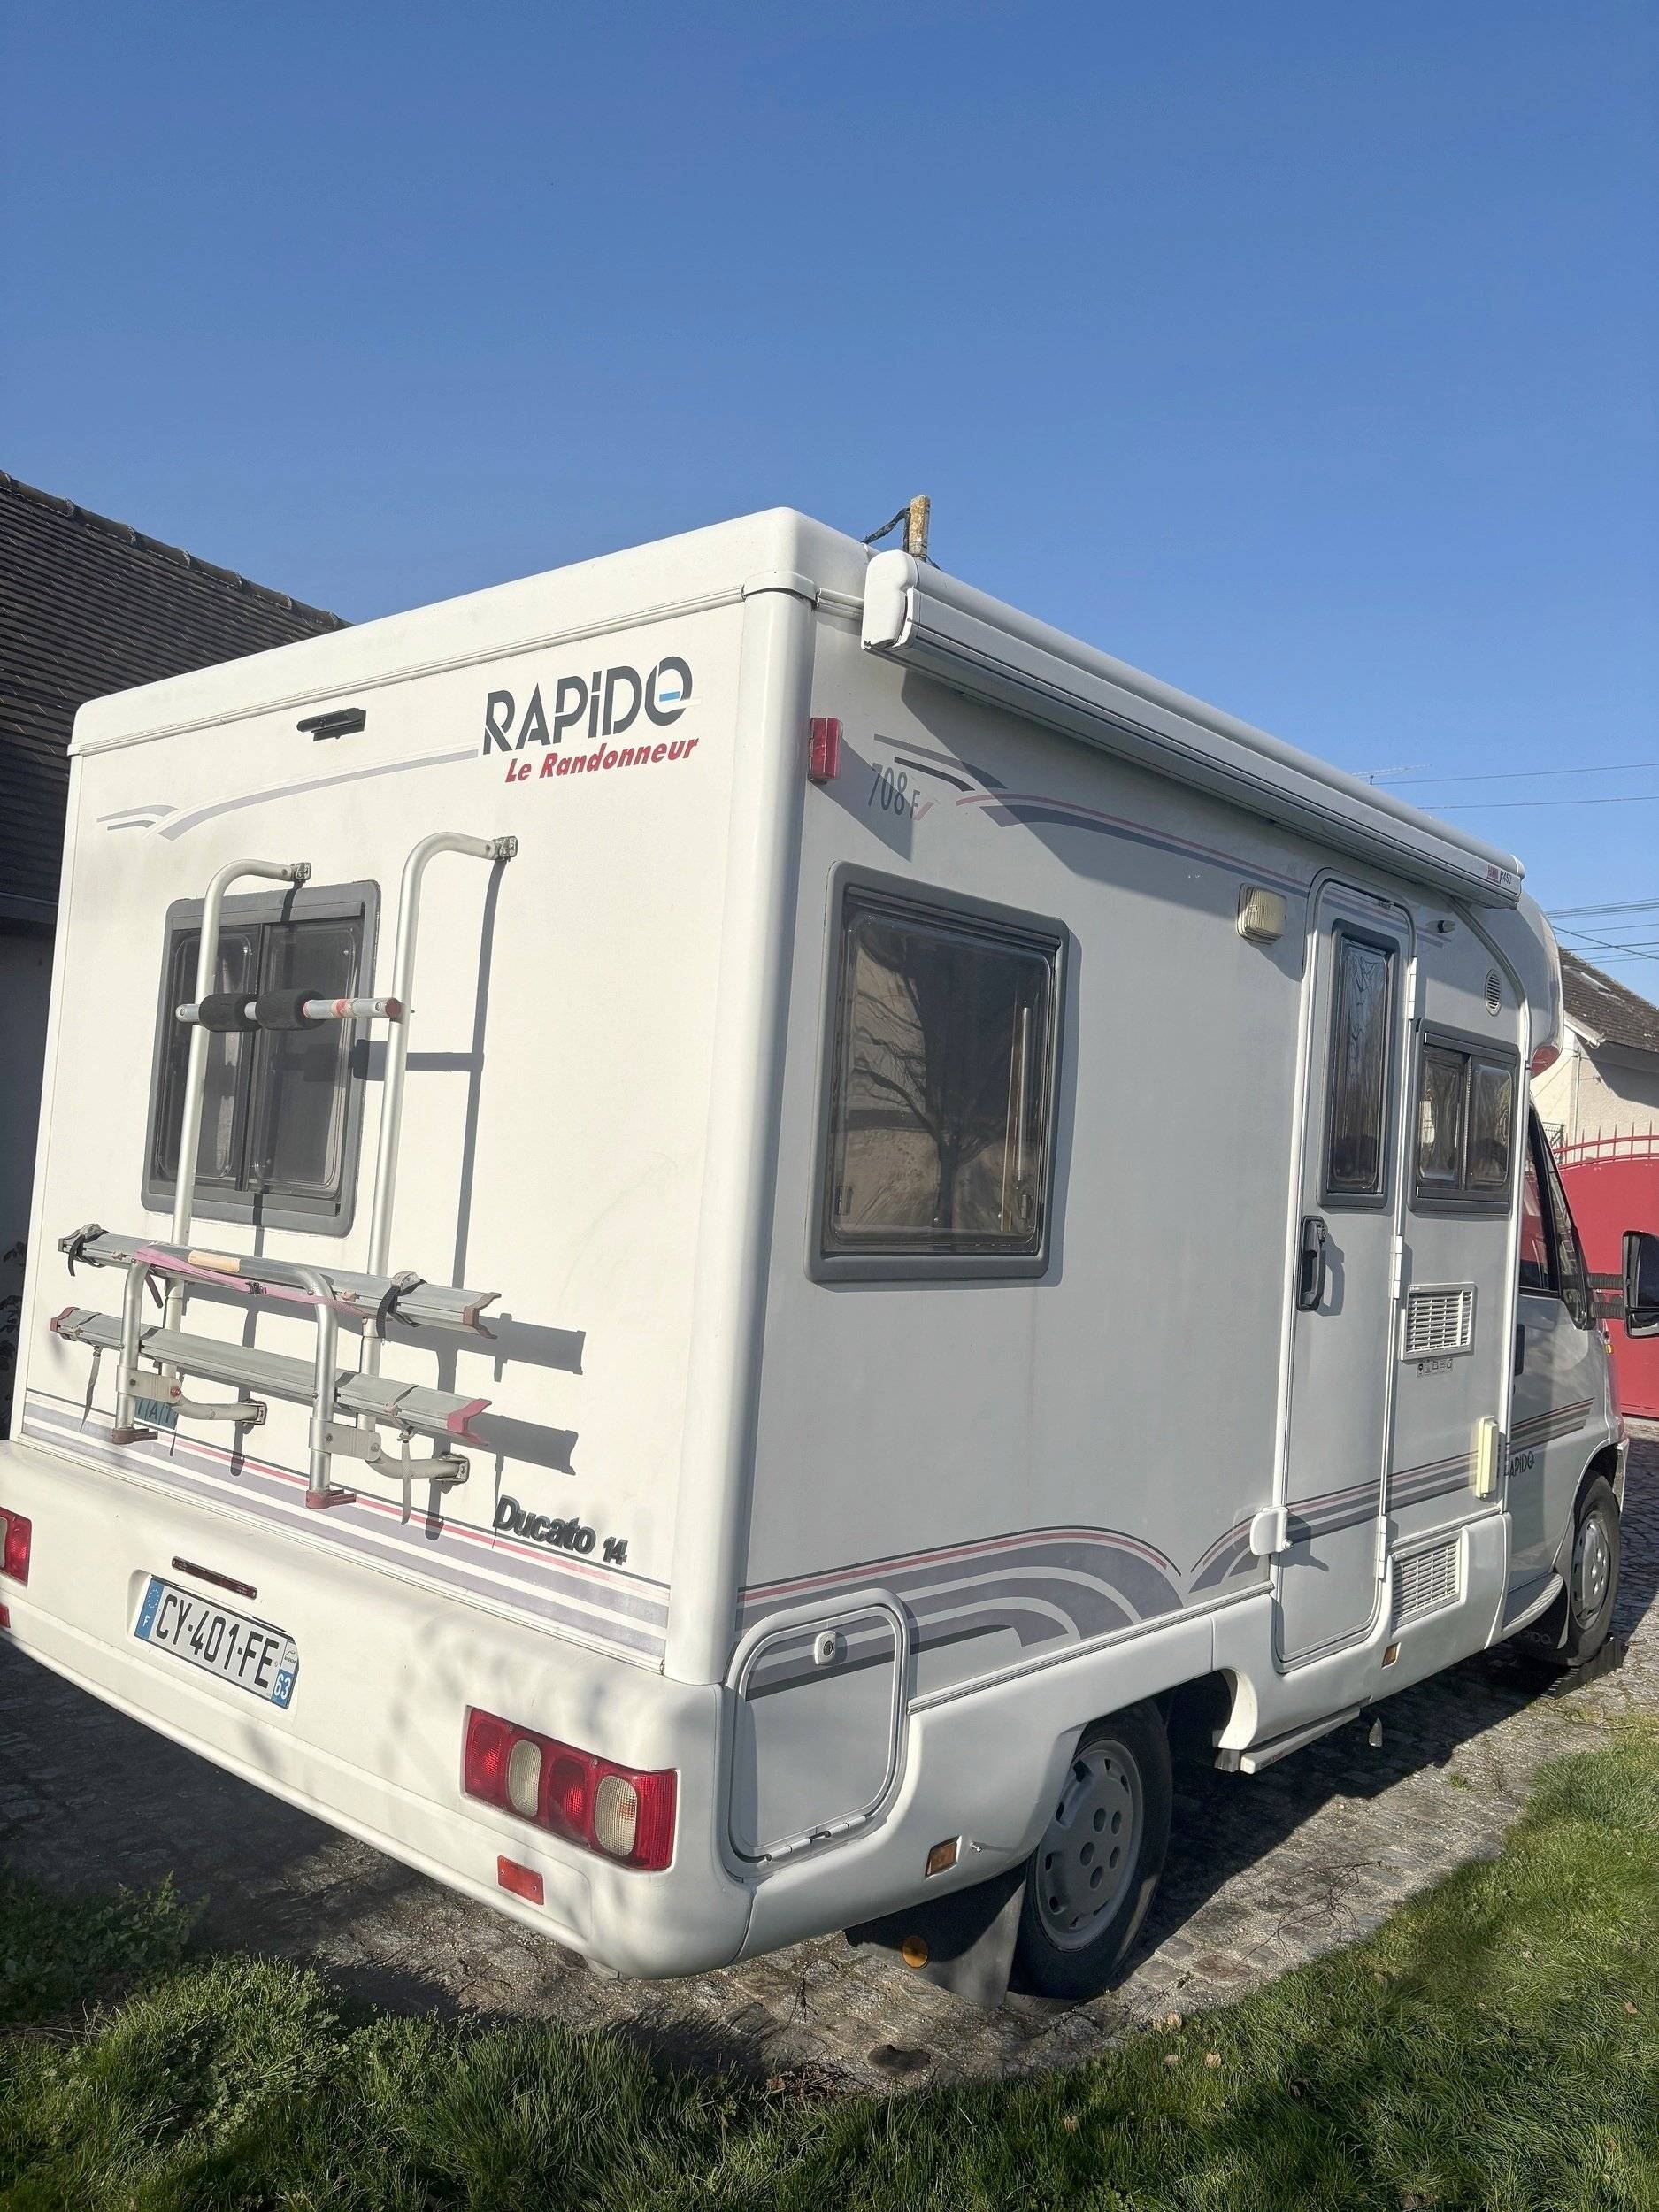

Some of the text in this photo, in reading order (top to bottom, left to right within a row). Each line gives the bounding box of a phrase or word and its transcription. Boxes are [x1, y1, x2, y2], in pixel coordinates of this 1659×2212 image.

[505, 738, 700, 783] Le Randonneur
[867, 763, 908, 816] 708
[493, 1494, 629, 1566] Ducato 14
[273, 1673, 292, 1701] 63
